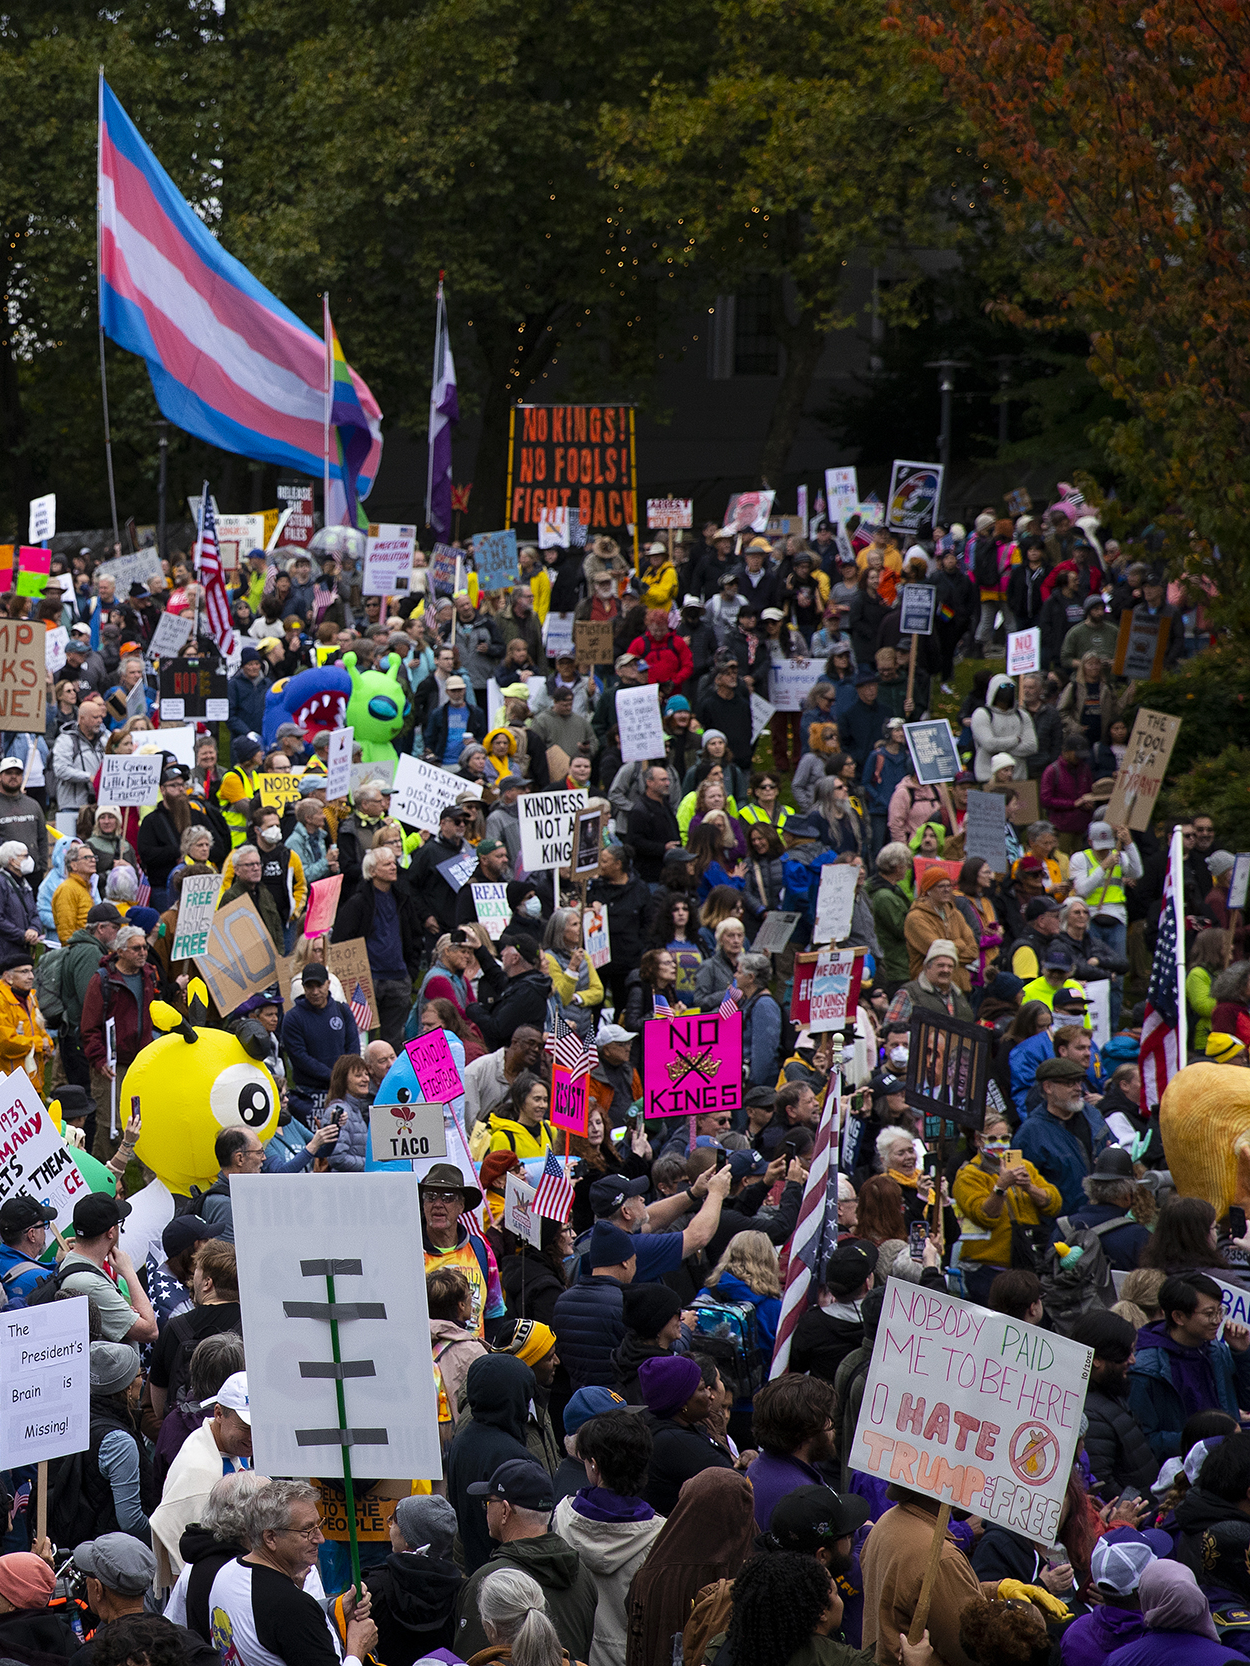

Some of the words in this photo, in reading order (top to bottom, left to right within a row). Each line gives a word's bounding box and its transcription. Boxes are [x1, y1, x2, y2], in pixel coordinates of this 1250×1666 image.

[524, 407, 548, 442] NO
[552, 407, 627, 445] KINGS!
[520, 448, 547, 484] NO
[555, 448, 628, 485] FOOLS!
[512, 487, 571, 525] FIGHT
[1015, 634, 1032, 651] NO
[1147, 714, 1168, 733] THE
[1136, 731, 1167, 754] TOOL
[418, 763, 469, 792] DISSENT
[524, 793, 586, 818] KINDNESS
[535, 817, 562, 840] NOT
[186, 891, 215, 908] FREE
[174, 932, 209, 960] FREE
[193, 906, 276, 1008] NO
[343, 947, 358, 960] OF
[355, 957, 368, 971] IS
[816, 963, 830, 977] WE
[828, 961, 852, 976] DON'T
[811, 994, 824, 1009] DO
[823, 991, 846, 1008] KINGS
[811, 1010, 819, 1021] IN
[817, 1004, 846, 1021] AMERICA
[668, 1018, 720, 1050] NO
[410, 1043, 438, 1072] STAND
[554, 1080, 585, 1121] RESIST!
[650, 1083, 739, 1114] KINGS
[389, 1136, 430, 1157] TACO
[27, 1152, 73, 1193] THEM
[7, 1323, 30, 1338] The
[888, 1286, 987, 1346] NOBODY
[1000, 1324, 1055, 1372] PAID
[21, 1340, 84, 1365] President's
[1080, 1349, 1093, 1381] 10/2025
[12, 1385, 41, 1403] Brain
[62, 1375, 73, 1389] is
[882, 1327, 934, 1378] ME
[941, 1346, 977, 1389] TO
[978, 1357, 1019, 1404] BE
[1016, 1373, 1080, 1429] HERE
[24, 1416, 70, 1440] Missing!
[895, 1391, 1001, 1462] HATE
[862, 1429, 986, 1508] TRUMP
[979, 1475, 998, 1510] FOR
[321, 1501, 338, 1517] TO
[339, 1502, 381, 1518] THE
[988, 1474, 1062, 1541] FREE
